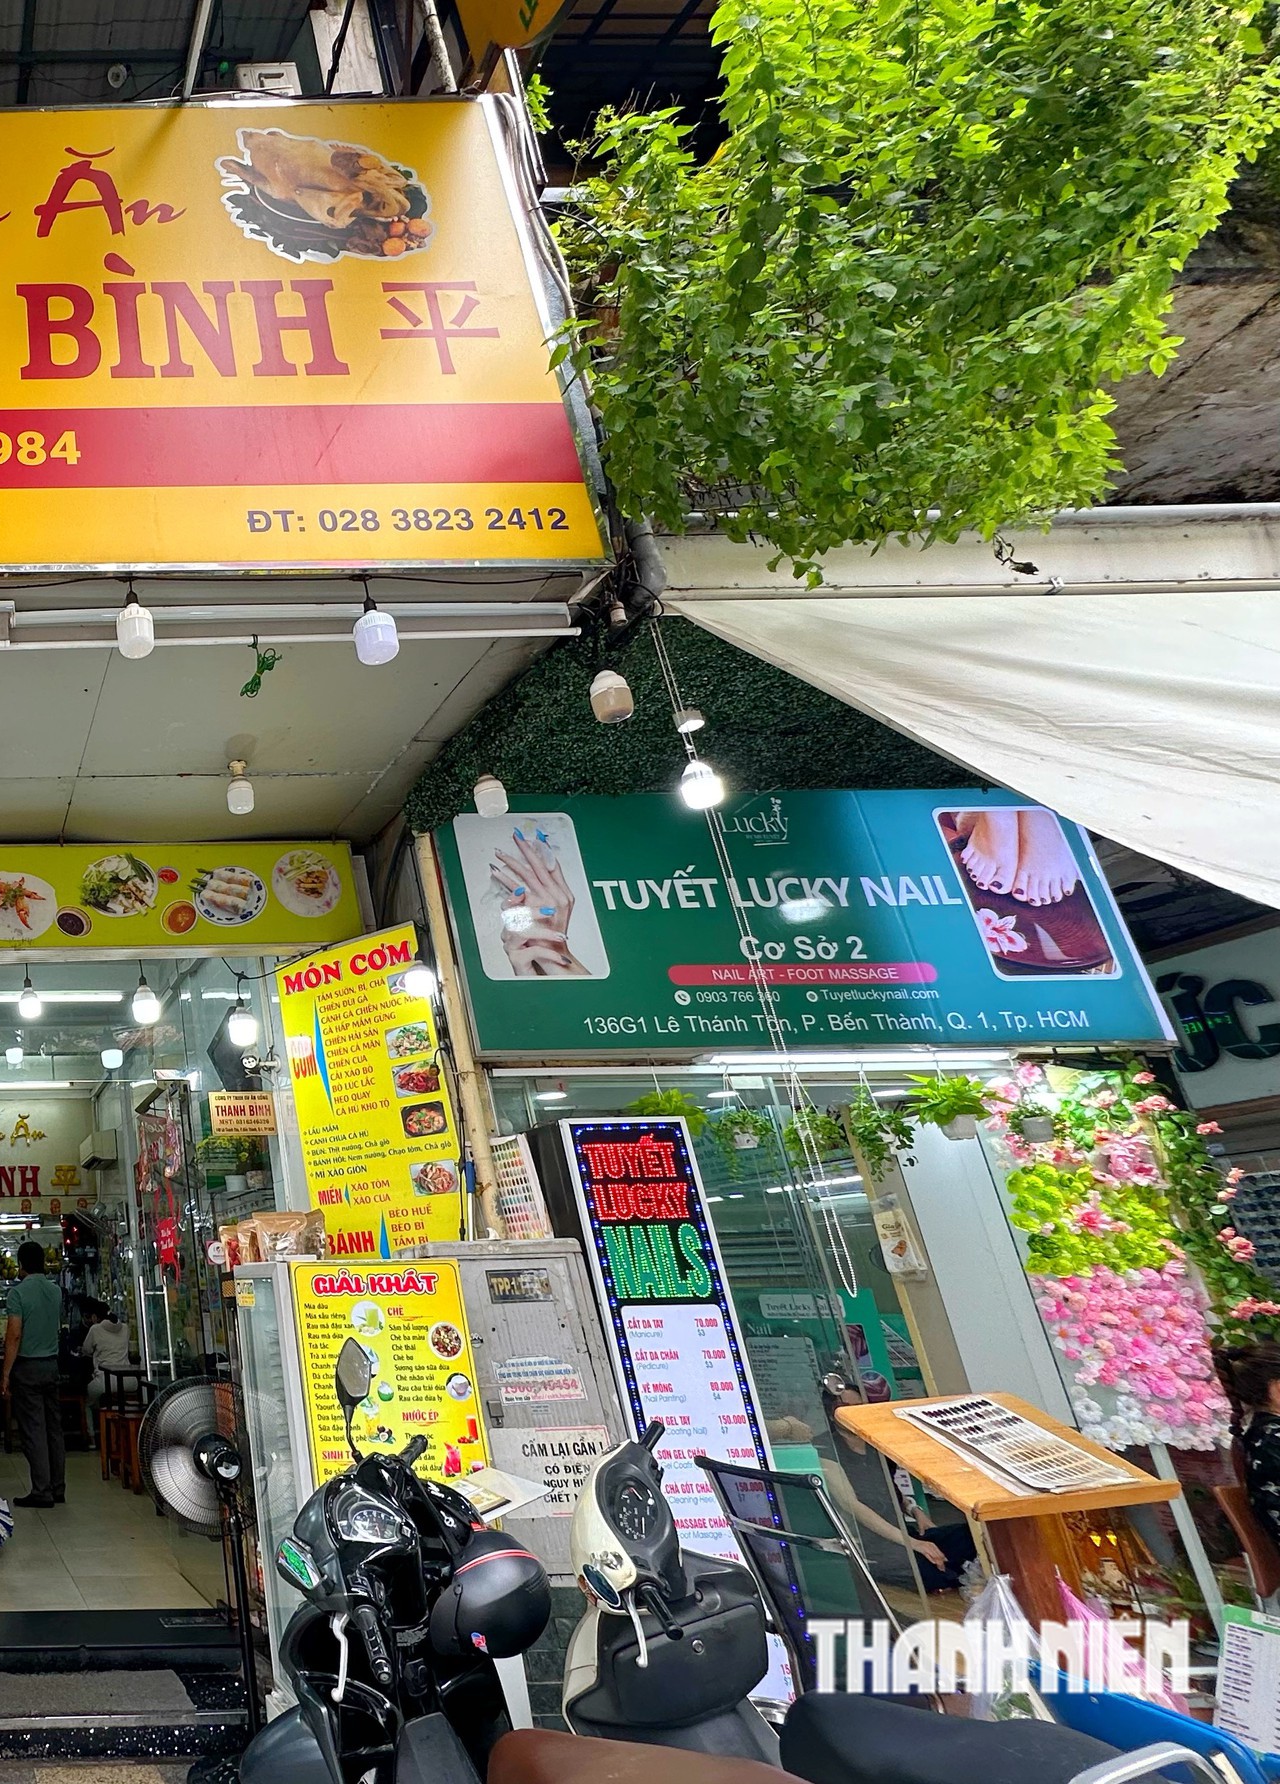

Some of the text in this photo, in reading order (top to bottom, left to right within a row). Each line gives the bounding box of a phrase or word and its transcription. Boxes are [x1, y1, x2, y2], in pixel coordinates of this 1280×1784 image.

[34, 147, 189, 238] Ăn
[17, 253, 350, 381] BÌNH
[381, 281, 500, 375] 平
[247, 507, 569, 533] ĐT: 028 3823 2412
[717, 811, 789, 841] Lucky
[592, 865, 963, 911] TUYẾT LUCKY NAIL
[739, 934, 868, 961] Cơ Sở 2
[284, 940, 411, 995] MÓN CƠM
[712, 967, 900, 981] NAIL ART FOOT MASSAGE
[696, 990, 728, 1003] 0903
[730, 990, 754, 1003] 766
[821, 988, 939, 1003] Tuyetluckynail.com
[583, 1011, 1090, 1035] 136G1 Lê Thánh Tôn, P. Bến Thành, Q. 1, Tp. HCM
[352, 1055, 368, 1065] CUA
[334, 1090, 371, 1105] HEO QUAY
[215, 1102, 272, 1118] THANH BÌNH
[361, 1099, 390, 1112] KHO TỘ
[309, 1135, 347, 1146] CANH CHUA
[348, 1153, 363, 1162] Nem
[388, 1146, 406, 1156] Chạo
[582, 1133, 678, 1179] TUYẾT
[351, 1179, 390, 1192] XÀO TÔM
[317, 1183, 343, 1206] MIẾN
[353, 1193, 391, 1206] XÀO CUA
[592, 1182, 690, 1220] LUCKY
[389, 1203, 433, 1218] BÈO HUẾ
[391, 1221, 411, 1233] BÈO
[328, 1228, 375, 1256] BÁNH
[601, 1223, 712, 1299] NAILS
[313, 1269, 437, 1295] GIẢI KHÁT
[387, 1305, 404, 1316] CHÈ
[642, 1318, 718, 1329] DA TAY 70.000
[697, 1329, 705, 1337] $3
[649, 1351, 659, 1360] DA
[702, 1350, 726, 1360] 70.000
[705, 1361, 713, 1369] $3
[652, 1382, 734, 1393] MÓNG 80.000
[402, 1409, 439, 1421] NƯỚC ÉP
[666, 1415, 746, 1426] GEL TAY 150.000
[522, 1436, 604, 1459] CẤM LẠI GẦN !
[673, 1448, 755, 1460] GEL 150.000
[322, 1451, 344, 1460] SINH
[544, 1463, 591, 1475] CÓ ĐIỆN
[543, 1478, 569, 1488] NGUY
[681, 1482, 764, 1493] GÓT 150.000
[543, 1490, 571, 1503] CHẾT
[673, 1518, 707, 1529] MASSAGE
[693, 1531, 722, 1540] Massage
